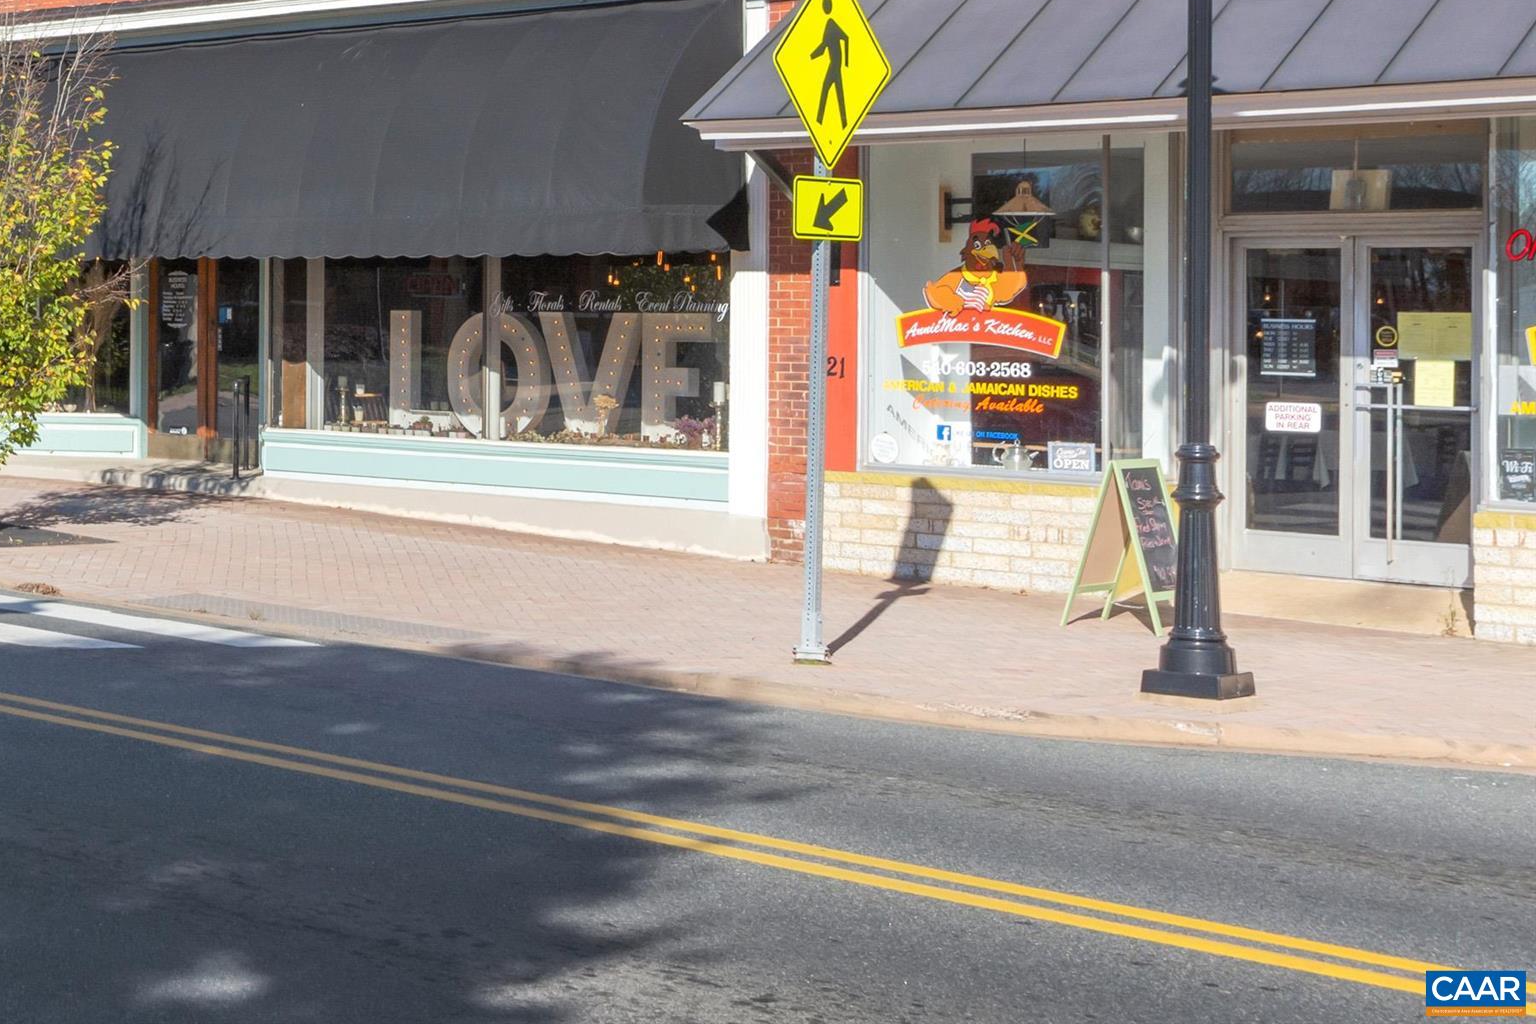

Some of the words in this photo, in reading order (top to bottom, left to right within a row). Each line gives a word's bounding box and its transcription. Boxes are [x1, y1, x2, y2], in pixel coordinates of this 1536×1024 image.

[489, 291, 514, 318] Gifts
[527, 290, 564, 312] Florals
[578, 289, 622, 313] Rentals
[634, 290, 670, 313] Event
[673, 290, 729, 322] Planning
[984, 319, 1036, 341] Kitchen,
[1038, 336, 1053, 346] LLC
[389, 310, 714, 441] LOVE
[827, 356, 845, 379] 21
[883, 379, 945, 393] AMERICAN
[962, 382, 1025, 397] JAMAICAN
[1028, 384, 1078, 399] DISHES
[975, 396, 1044, 414] Available
[1268, 404, 1318, 413] ADDITIONAL
[1275, 413, 1311, 421] PARKING
[1054, 457, 1089, 470] OPEN
[1502, 460, 1534, 473] Wi-Fi
